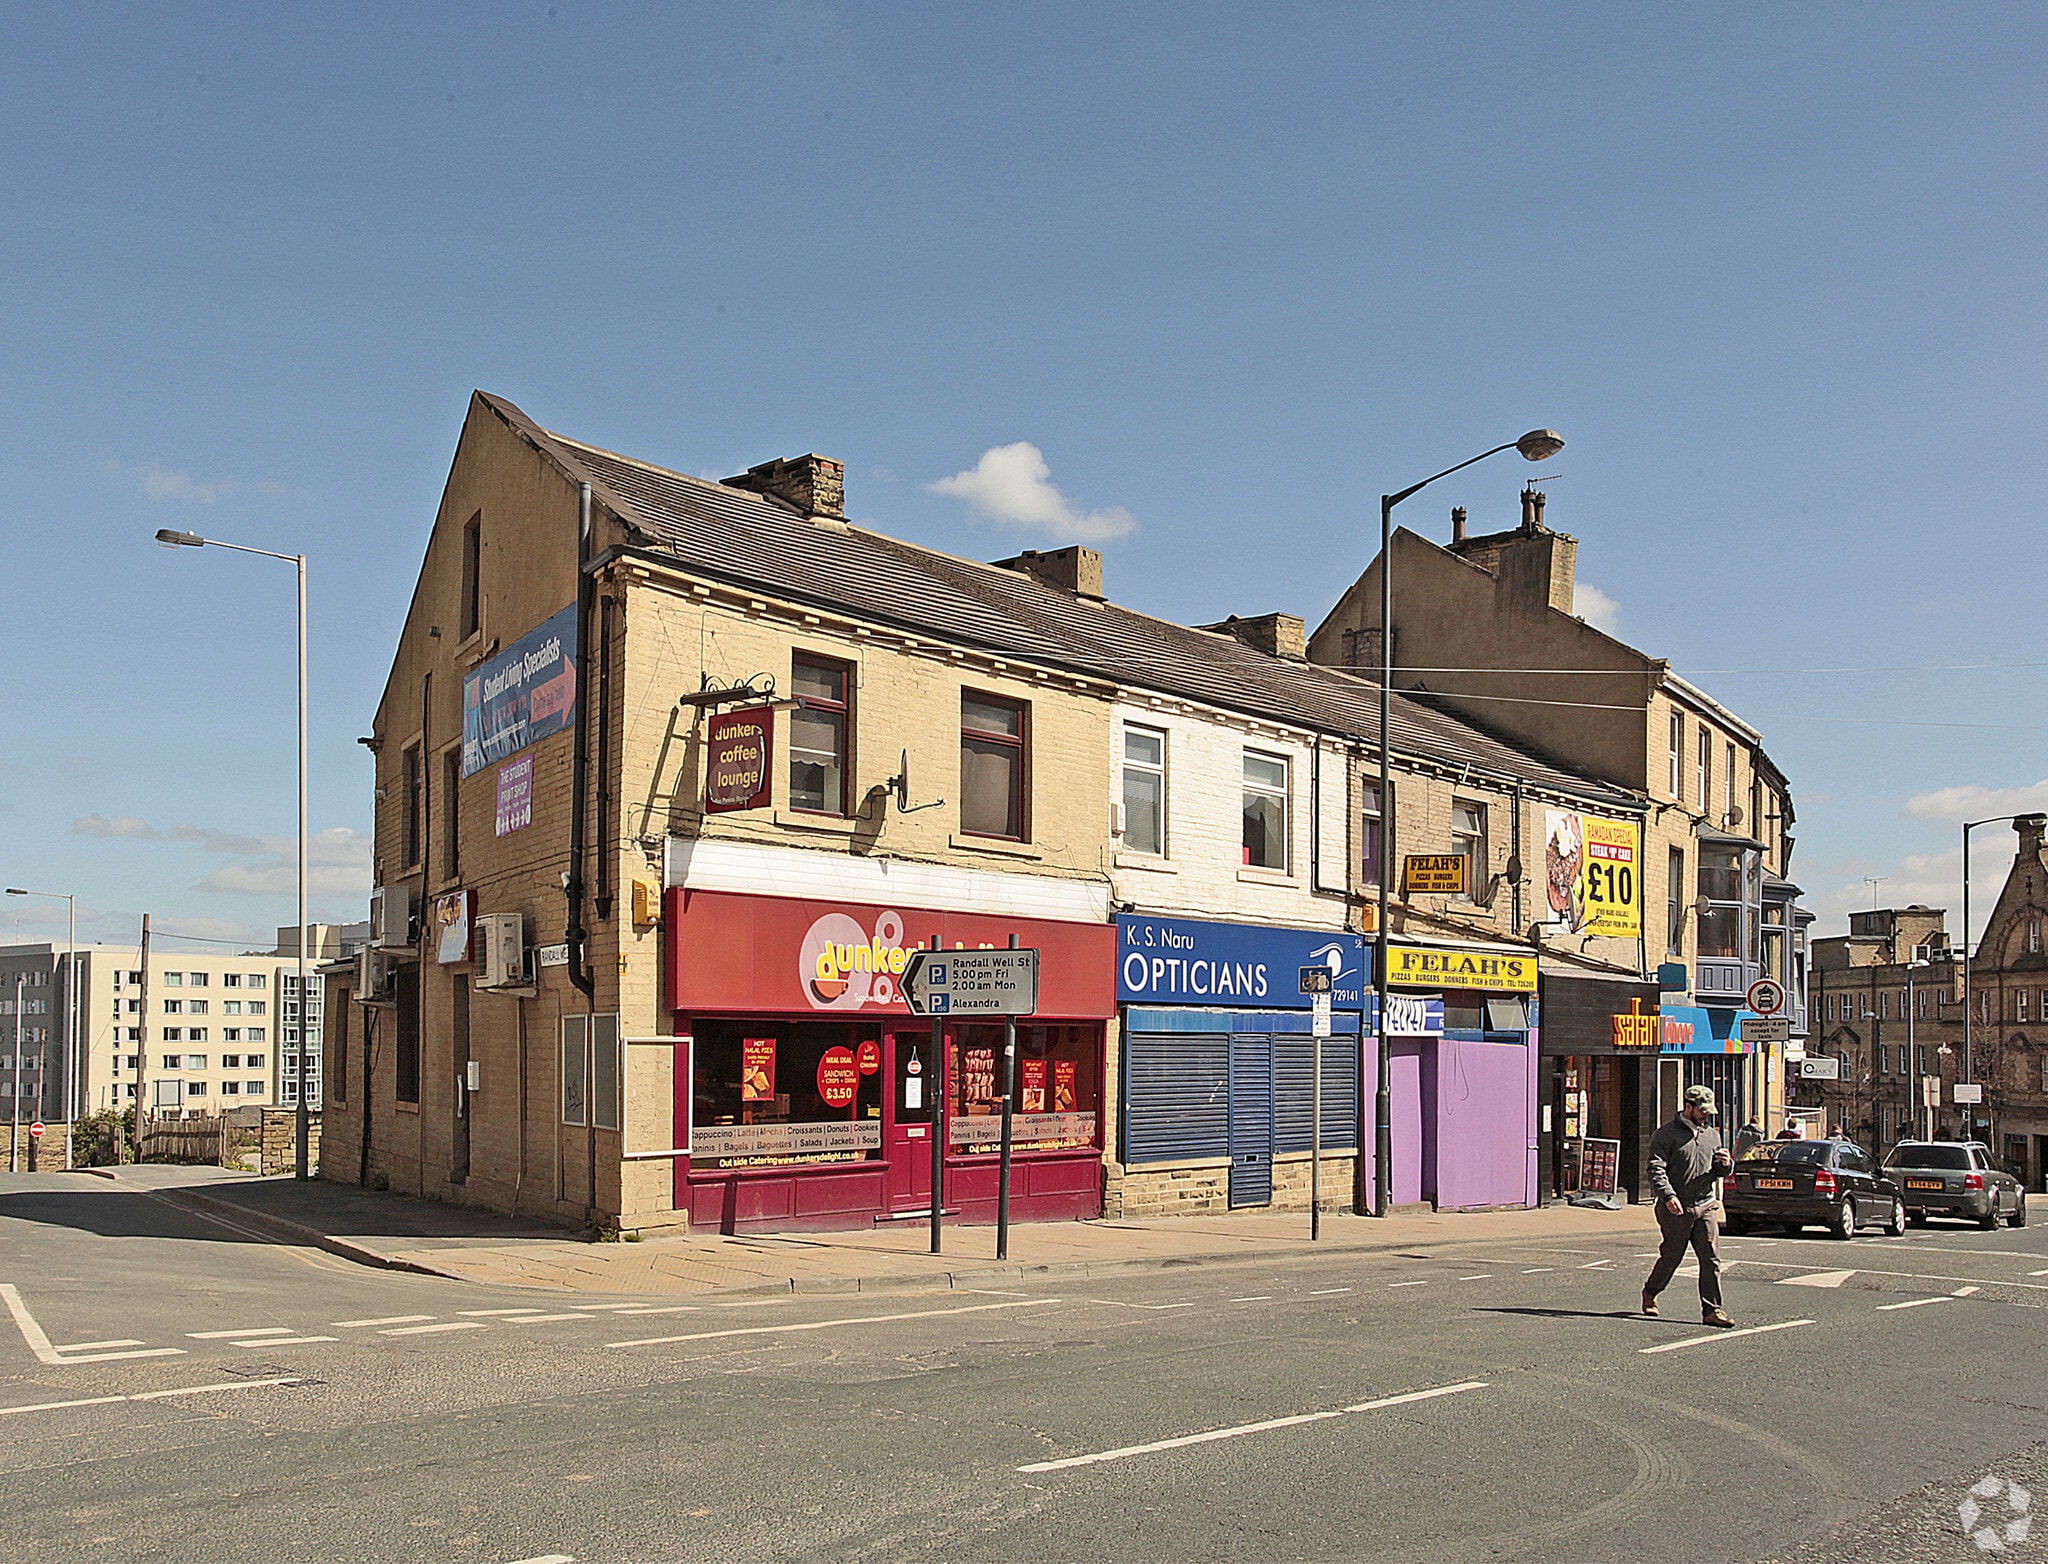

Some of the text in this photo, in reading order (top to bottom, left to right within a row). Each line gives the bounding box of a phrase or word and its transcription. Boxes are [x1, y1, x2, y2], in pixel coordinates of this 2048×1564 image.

[483, 636, 560, 703] Student Living Specialists
[720, 745, 757, 763] coffee
[717, 771, 758, 788] lounge
[1410, 858, 1460, 870] FELAH'S
[1588, 862, 1632, 905] £10
[1127, 925, 1194, 949] K. S. Naru
[953, 958, 1030, 968] Randall Well St
[1400, 952, 1523, 978] FELAH'S
[952, 969, 1008, 980] 5.00 pm Fri
[1124, 952, 1268, 997] OPTICIANS
[1391, 972, 1410, 980] PIZZAS
[1416, 974, 1440, 982] BURGERS
[952, 981, 976, 990] 2.00
[994, 980, 1016, 990] Mon
[952, 998, 1000, 1008] Alexandra
[1613, 997, 1660, 1046] safari
[826, 1088, 852, 1099] £3.50
[787, 1126, 822, 1135] Croissants
[826, 1126, 849, 1134] Donuts
[724, 1142, 748, 1152] Bagels
[757, 1140, 792, 1150] Baguettes
[800, 1138, 822, 1147] Salads
[830, 1137, 854, 1146] Jackets
[862, 1136, 878, 1145] Soup
[719, 1158, 732, 1168] Out
[733, 1158, 747, 1166] side
[749, 1156, 778, 1166] Catering
